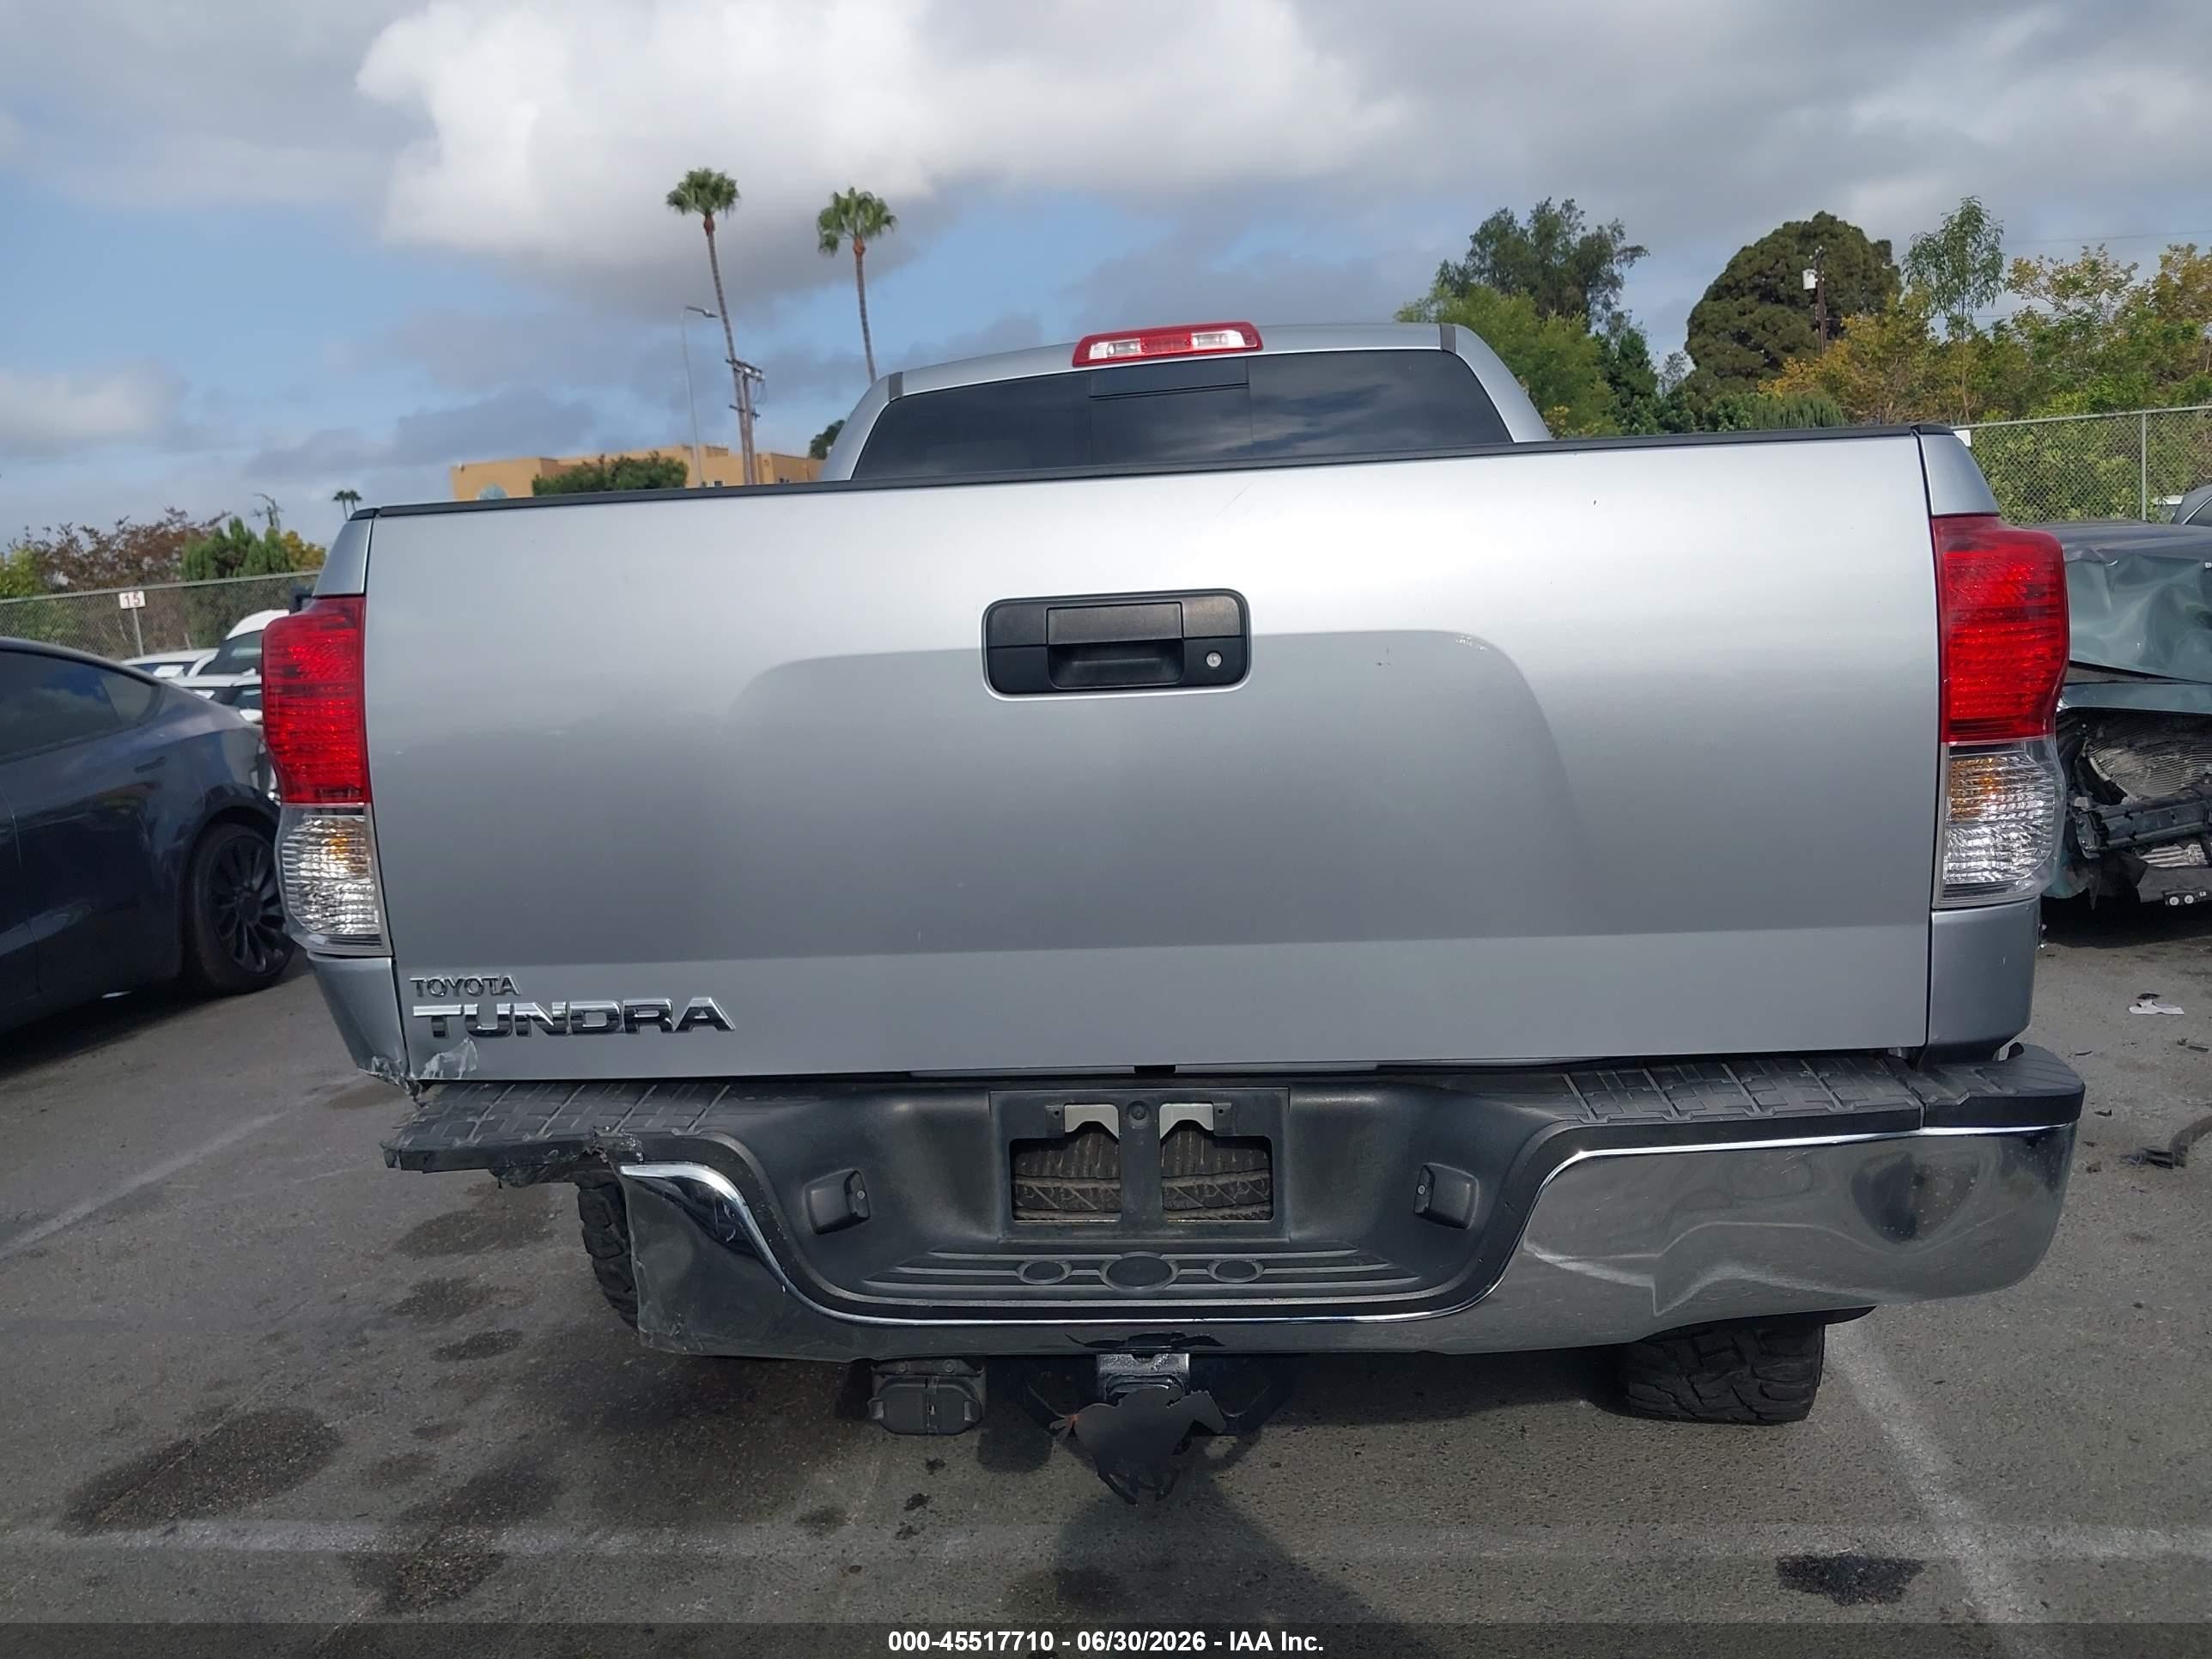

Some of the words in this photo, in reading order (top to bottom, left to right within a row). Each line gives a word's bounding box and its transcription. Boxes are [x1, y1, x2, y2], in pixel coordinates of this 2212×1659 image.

[124, 593, 141, 606] 15
[410, 975, 522, 997] TOYOTA
[412, 997, 736, 1038] TUNDRA
